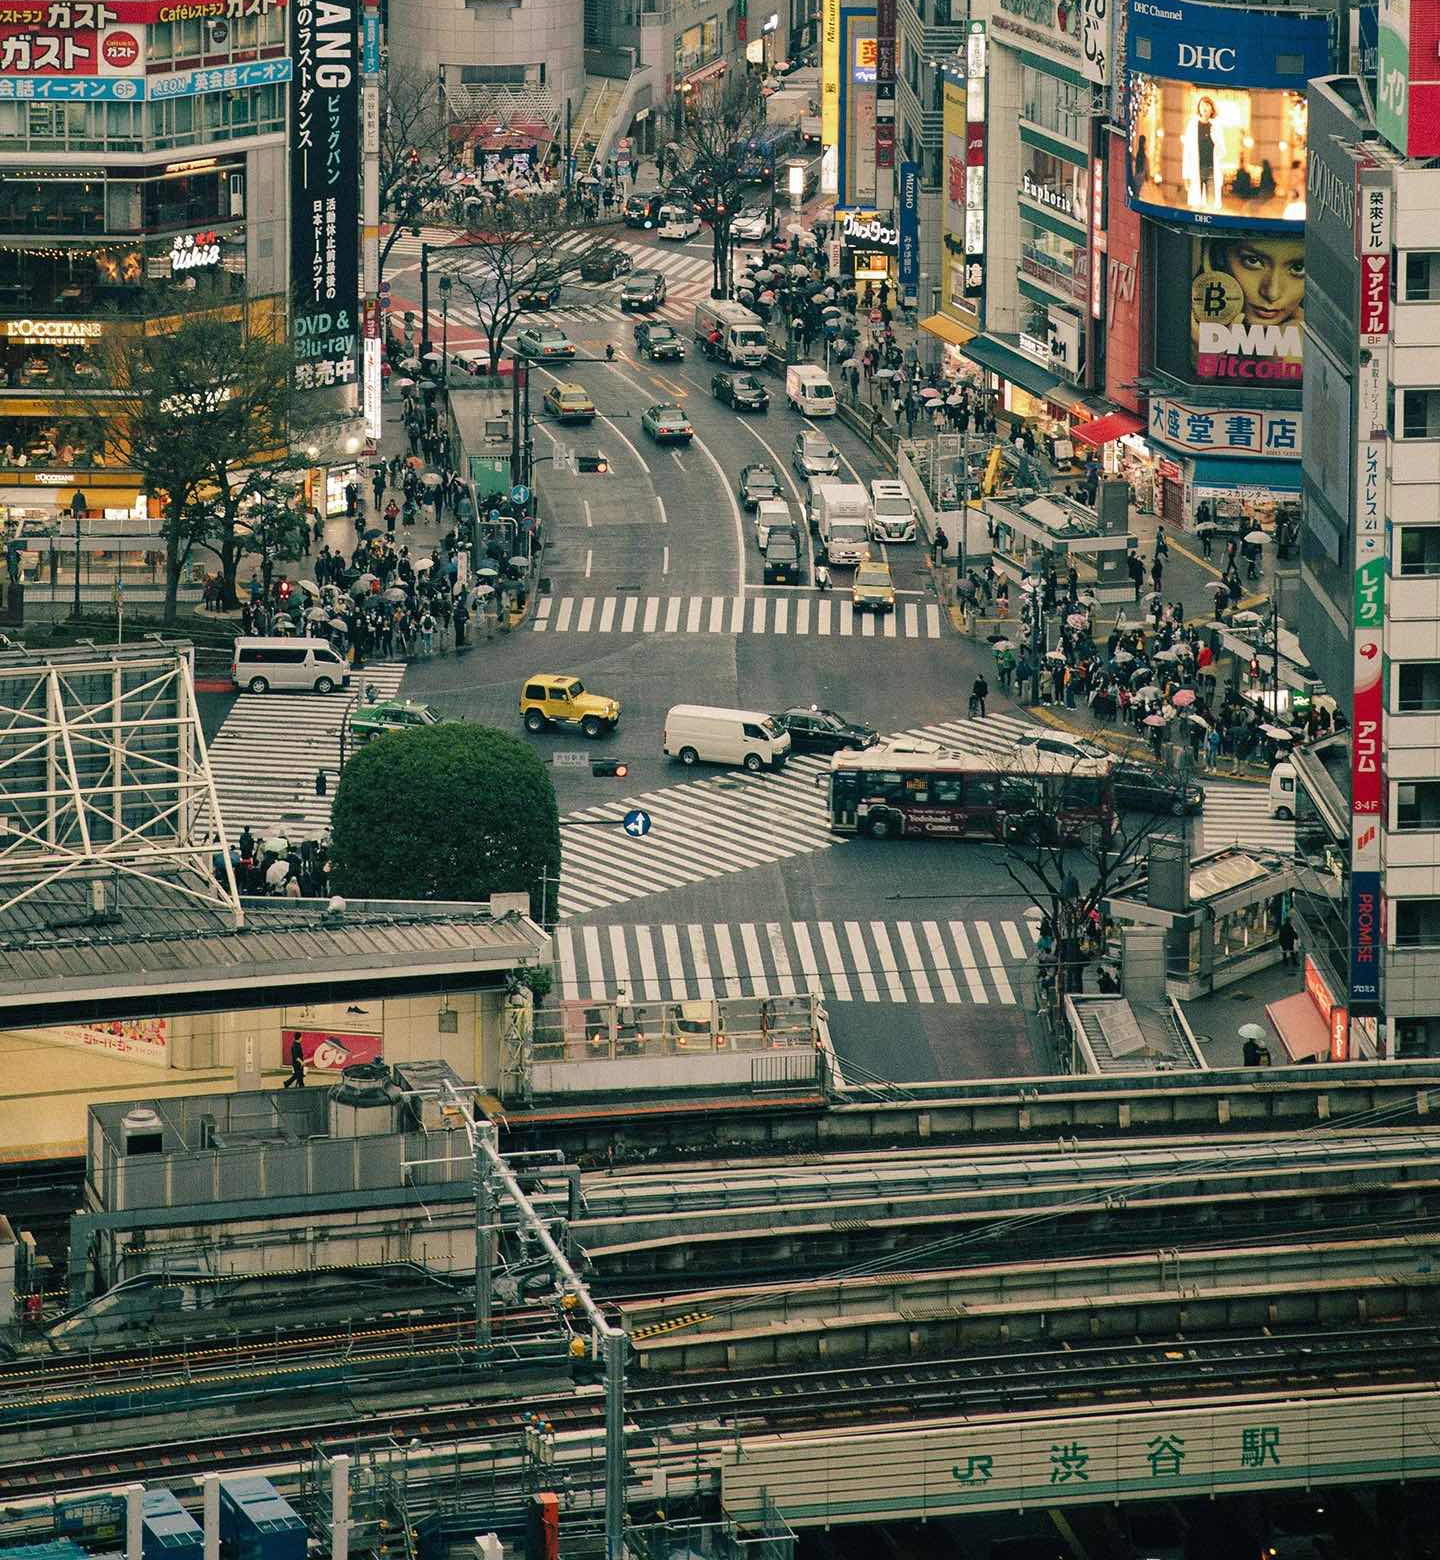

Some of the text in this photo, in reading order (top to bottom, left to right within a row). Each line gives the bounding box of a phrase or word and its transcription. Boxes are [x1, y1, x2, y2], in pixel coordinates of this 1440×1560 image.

[48, 2, 117, 30] ガスト
[1133, 1, 1183, 21] DHC Channel
[0, 34, 90, 71] ガスト
[106, 46, 136, 58] ガスト
[1178, 44, 1236, 72] DHC
[194, 63, 289, 90] 英会話イーオン
[326, 95, 341, 185] ビッグバン
[905, 172, 915, 209] MIZUHO
[1024, 176, 1071, 212] Euphoria
[843, 213, 897, 246] グルメタウン
[1194, 214, 1212, 224] DHC
[313, 200, 323, 302] 日本ドームツアー
[1367, 272, 1385, 333] アイフル
[294, 314, 332, 338] DVD
[336, 309, 350, 330] &
[1198, 322, 1304, 357] DMM
[294, 333, 355, 359] Blu-ray
[295, 356, 355, 391] 発売中
[1196, 355, 1303, 378] Bitcoin
[1152, 399, 1298, 449] 大盛堂書店
[1359, 568, 1378, 620] レイク
[1357, 720, 1377, 773] アコム
[1356, 893, 1373, 963] PROMISE
[1353, 984, 1376, 993] プロミス
[952, 1425, 1281, 1484] JR 渋谷駅
